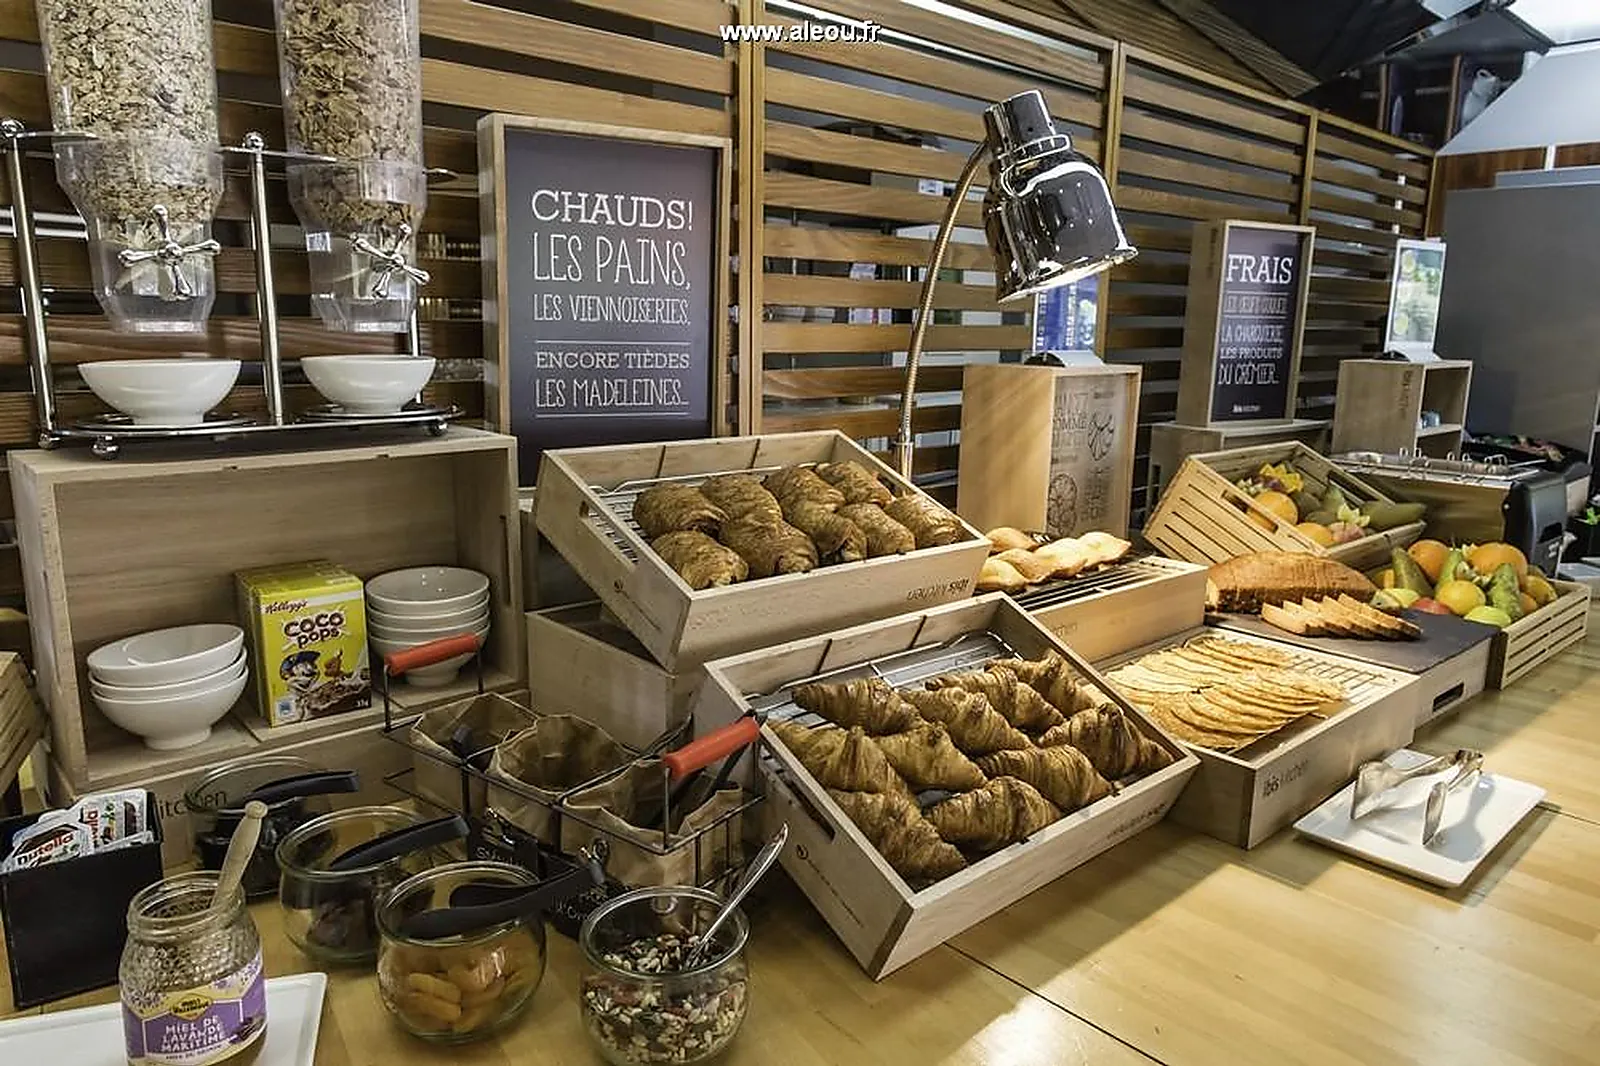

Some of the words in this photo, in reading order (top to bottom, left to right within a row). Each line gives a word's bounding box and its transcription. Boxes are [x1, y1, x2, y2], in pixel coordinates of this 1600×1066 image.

[531, 189, 694, 231] CHAUDS!
[533, 232, 583, 284] LES
[595, 236, 691, 291] PAINS,
[1226, 253, 1294, 285] FRAIS
[533, 293, 563, 322] LES
[535, 351, 620, 369] ENCORE
[626, 349, 690, 370] TIÈDES
[535, 378, 567, 409] LES
[17, 831, 75, 866] nutella
[165, 1021, 198, 1035] MIEL
